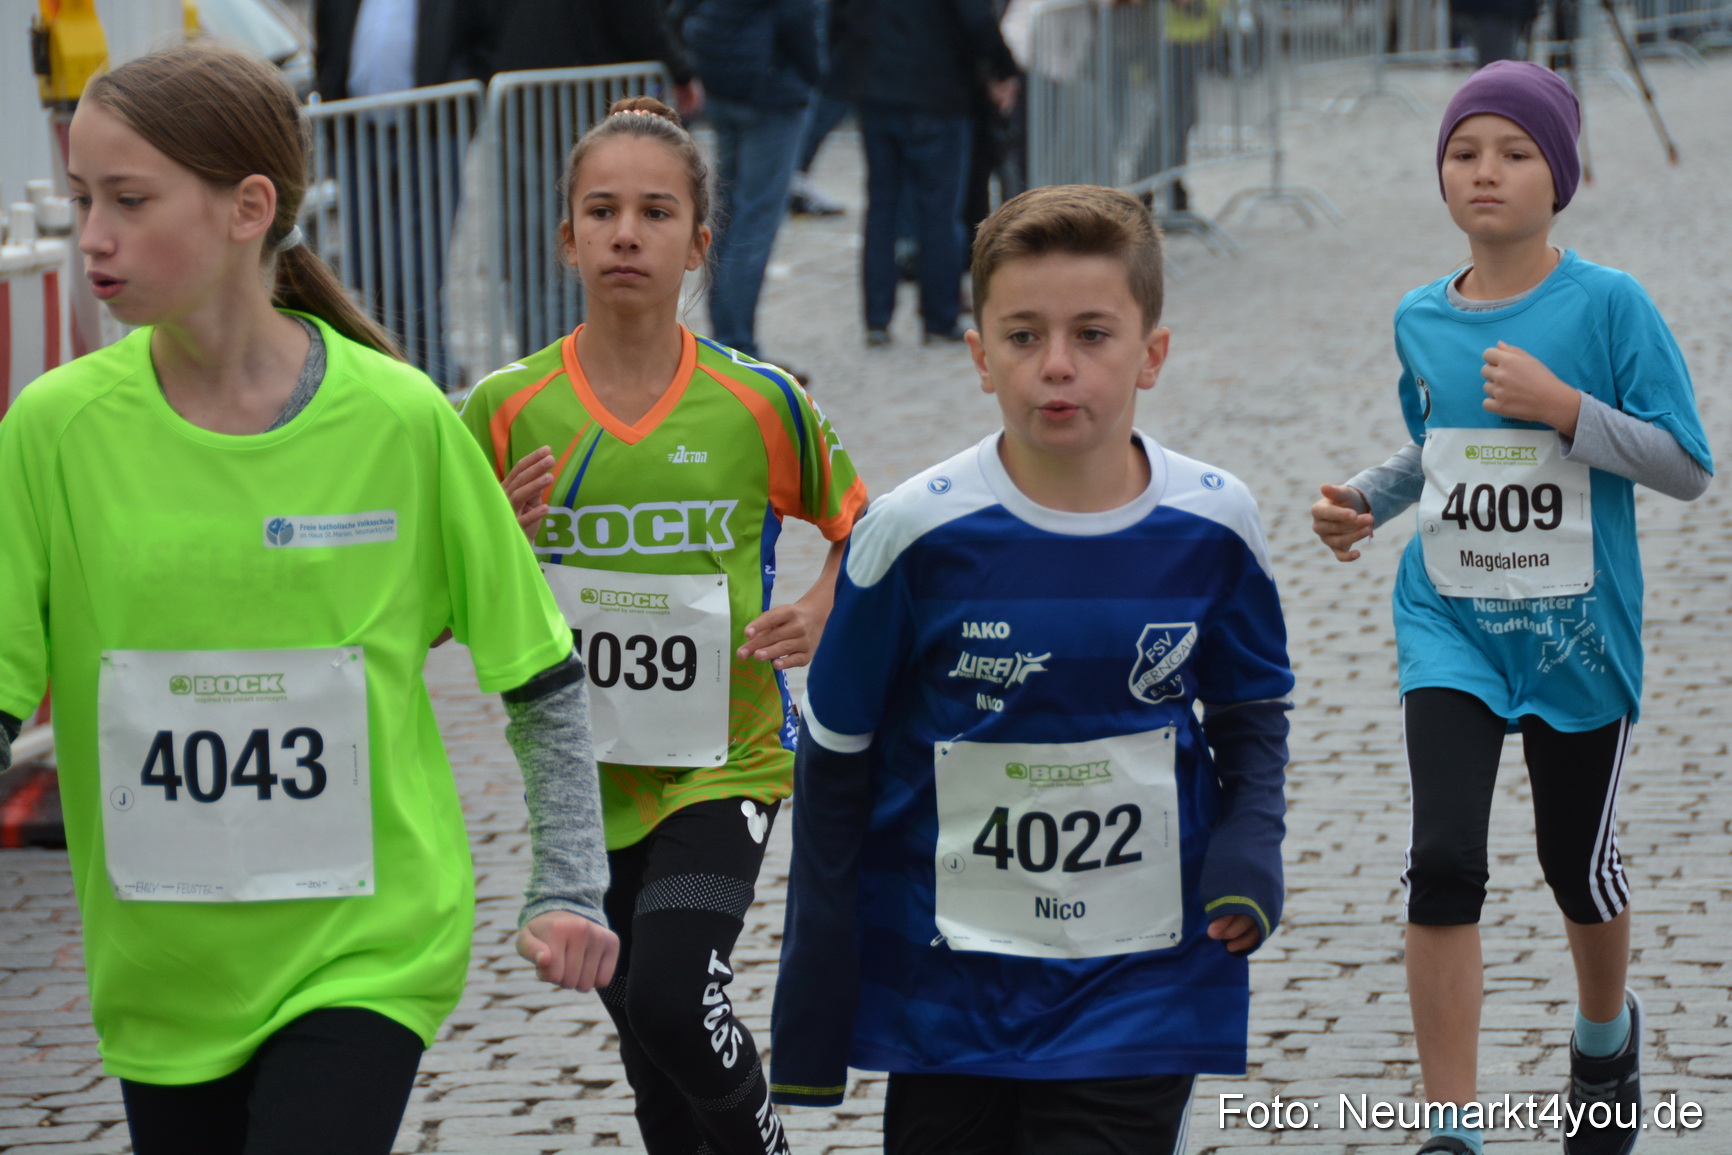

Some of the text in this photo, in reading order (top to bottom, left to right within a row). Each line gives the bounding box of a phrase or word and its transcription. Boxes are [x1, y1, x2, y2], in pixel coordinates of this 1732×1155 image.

[1481, 446, 1537, 460] BOCK
[1441, 483, 1563, 533] 4009
[319, 522, 356, 531] katholische
[357, 518, 395, 527] Volksschule
[532, 499, 739, 556] BOCK
[1460, 550, 1550, 572] Magdalena
[600, 589, 669, 610] BOCK
[1473, 597, 1575, 613] Neumarkter
[962, 621, 1010, 639] JAKO
[1145, 630, 1172, 664] FSV
[948, 650, 1014, 679] JURA
[193, 673, 286, 695] BOCK
[194, 696, 222, 704] inspired
[976, 692, 1004, 712] Nico
[141, 727, 327, 803] 4043
[1029, 759, 1111, 782] BOCK
[119, 792, 127, 806] J
[972, 803, 1142, 873] 4022
[950, 858, 958, 869] J
[1035, 896, 1086, 920] Nico
[702, 949, 743, 1069] SPORT
